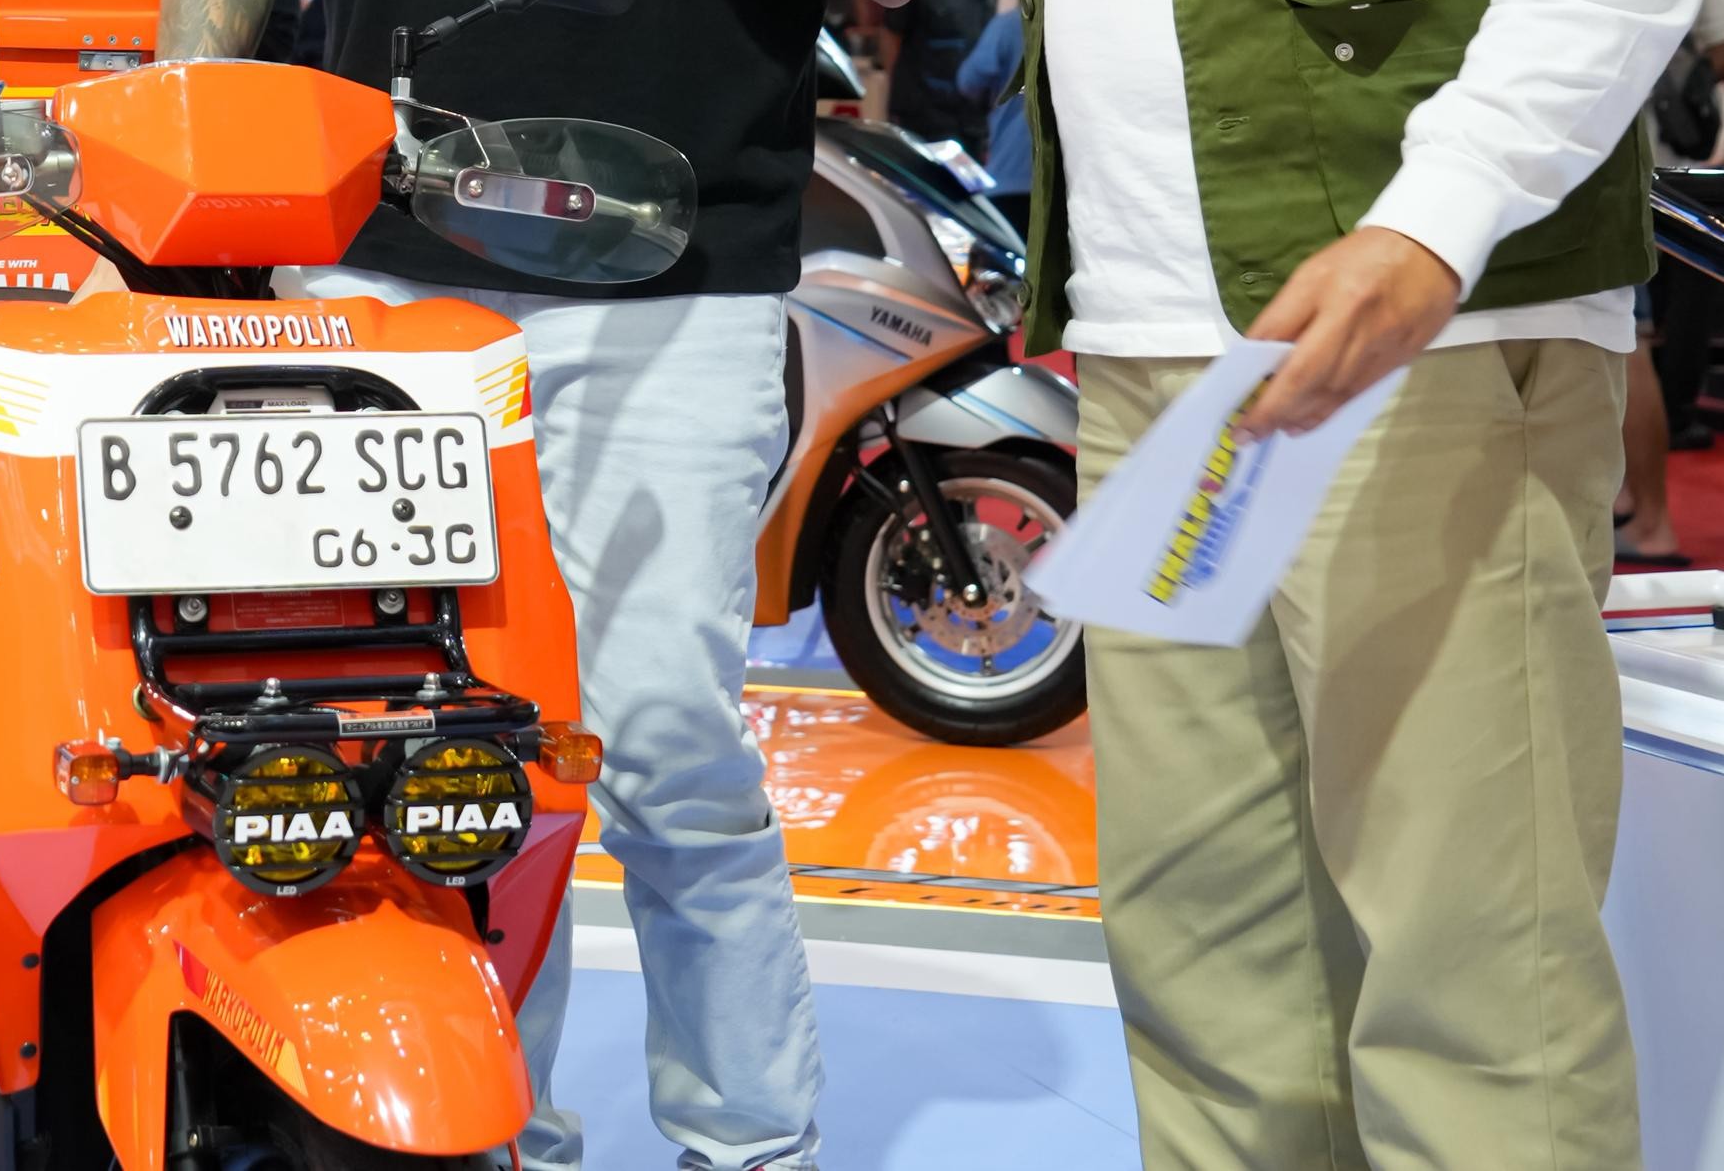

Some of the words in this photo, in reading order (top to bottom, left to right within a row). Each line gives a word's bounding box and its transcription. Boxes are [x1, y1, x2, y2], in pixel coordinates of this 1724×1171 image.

[8, 259, 38, 268] WITH
[164, 314, 355, 347] WARKOPOLIM
[870, 305, 933, 347] YAMAHA
[101, 434, 137, 501] B
[168, 431, 326, 497] 5762
[354, 427, 468, 493] SCG
[234, 810, 355, 844] PIAA
[405, 802, 523, 835] PIAA
[276, 884, 298, 896] LED
[445, 876, 466, 887] LED
